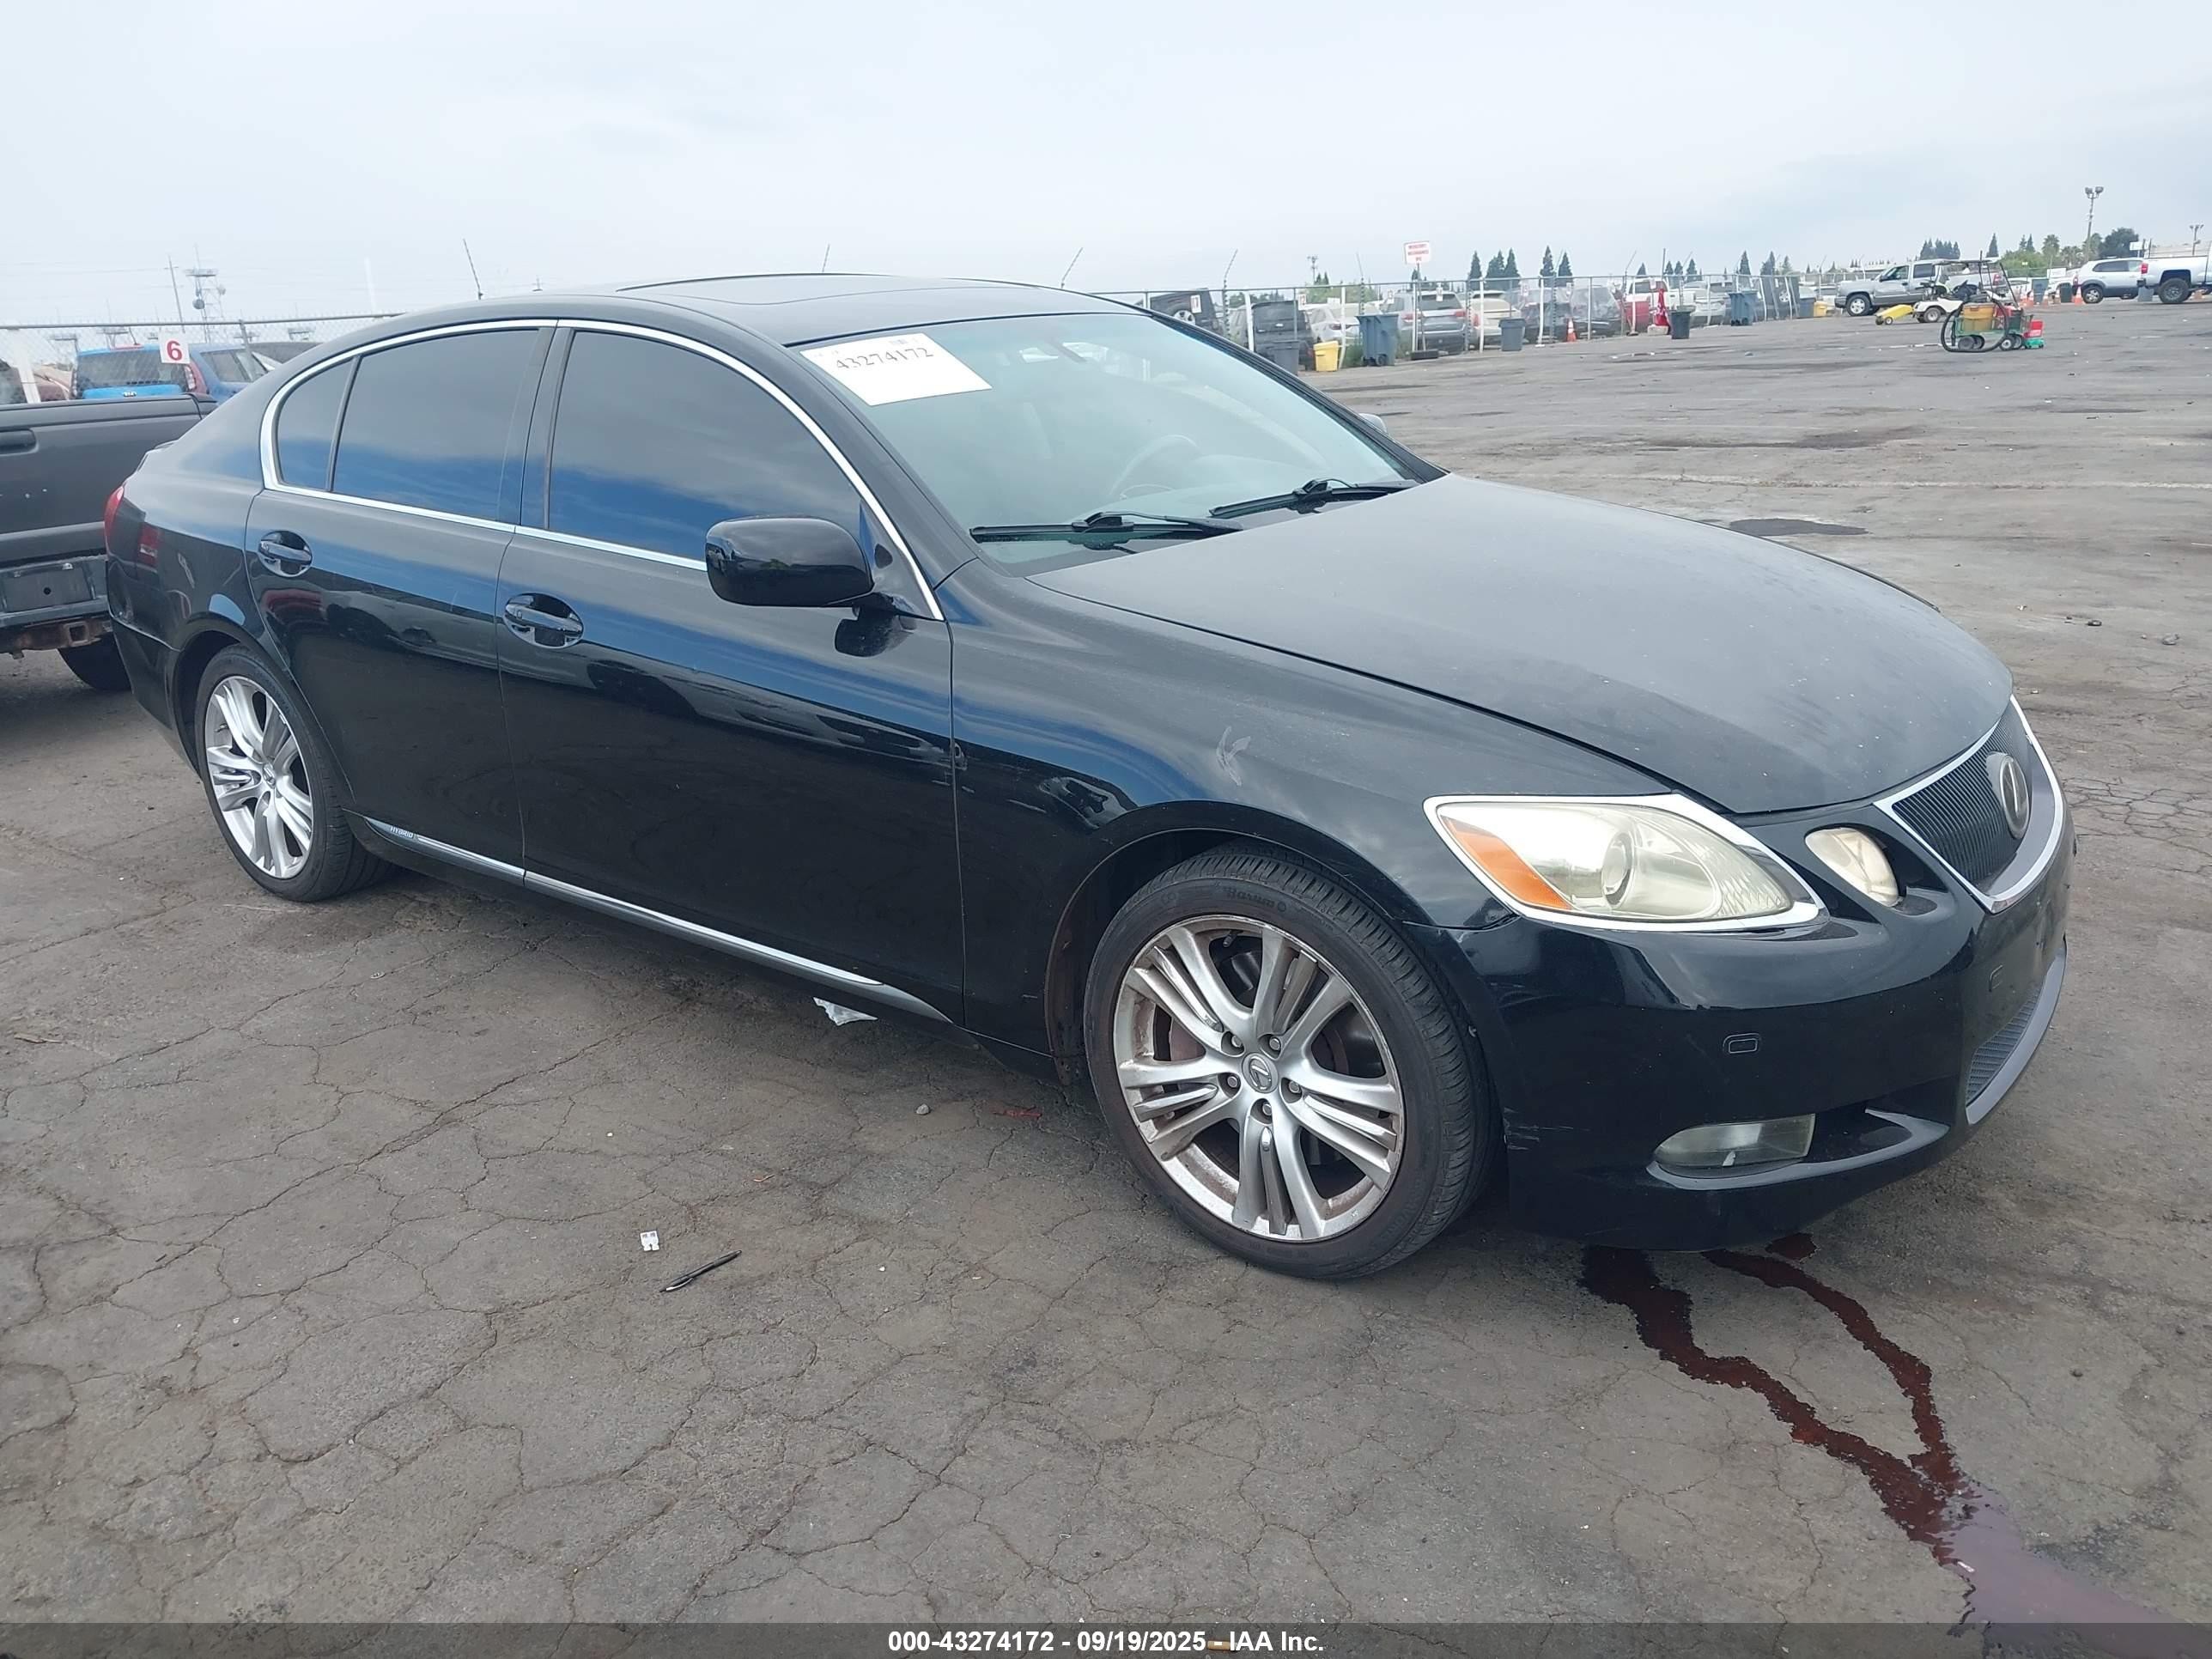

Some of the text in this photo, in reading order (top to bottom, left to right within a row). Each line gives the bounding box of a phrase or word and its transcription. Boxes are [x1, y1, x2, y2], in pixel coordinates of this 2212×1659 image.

[167, 341, 183, 361] 6
[836, 347, 933, 369] 43274172
[390, 825, 414, 839] HYBRID
